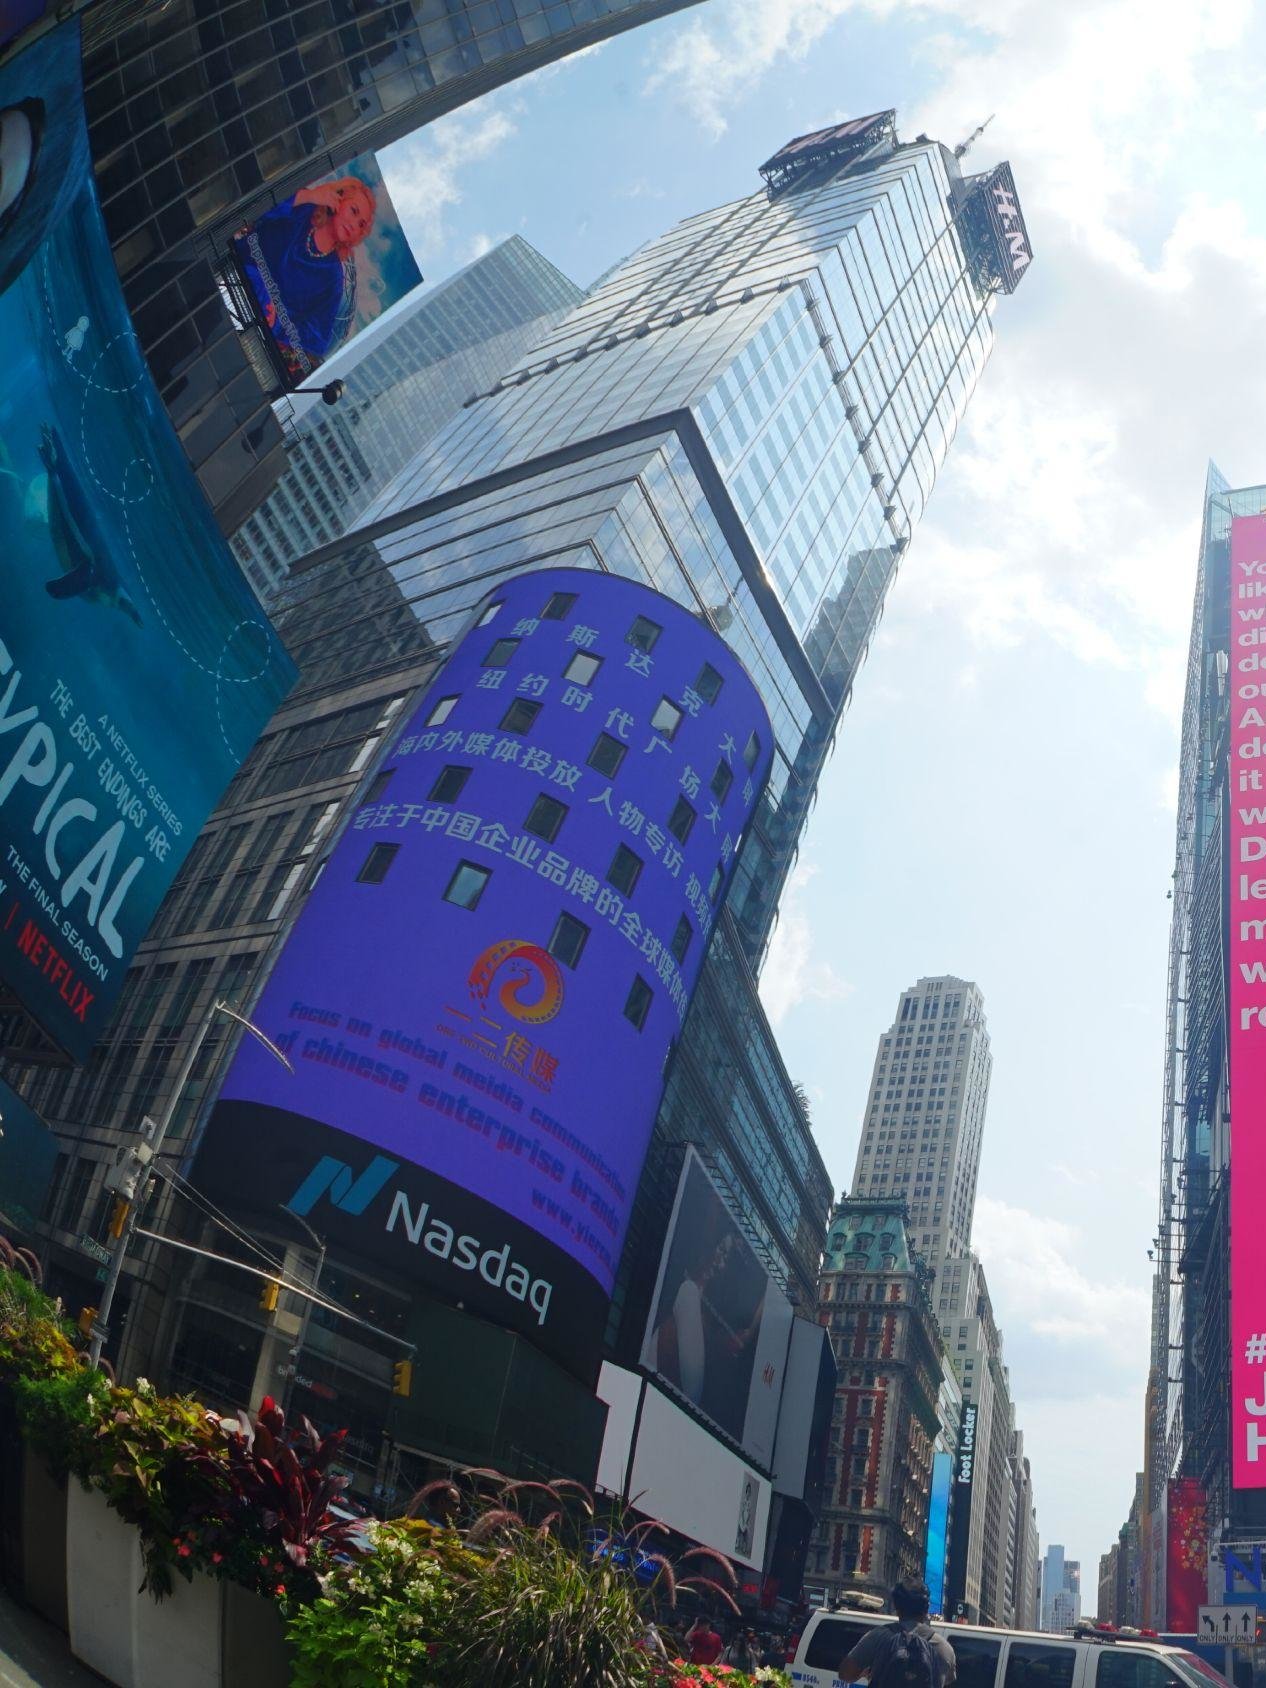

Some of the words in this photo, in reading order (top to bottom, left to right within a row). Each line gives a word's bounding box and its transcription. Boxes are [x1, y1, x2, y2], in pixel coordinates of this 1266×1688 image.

[993, 186, 1031, 272] H&M
[50, 679, 74, 719] THE
[69, 713, 102, 762] BEST
[98, 757, 148, 830] ENDINGS
[145, 825, 172, 864] ARE
[97, 713, 107, 728] A
[106, 724, 150, 795] NETFLIX
[146, 786, 184, 837] SERIES
[1239, 769, 1263, 792] it
[7, 845, 30, 884] THE
[28, 878, 63, 926] FINAL
[61, 920, 109, 982] SEASON
[17, 919, 95, 1023] NETFLIX
[385, 1190, 553, 1326] Nasdaq
[958, 1454, 972, 1483] Foot
[960, 1407, 976, 1451] Locker
